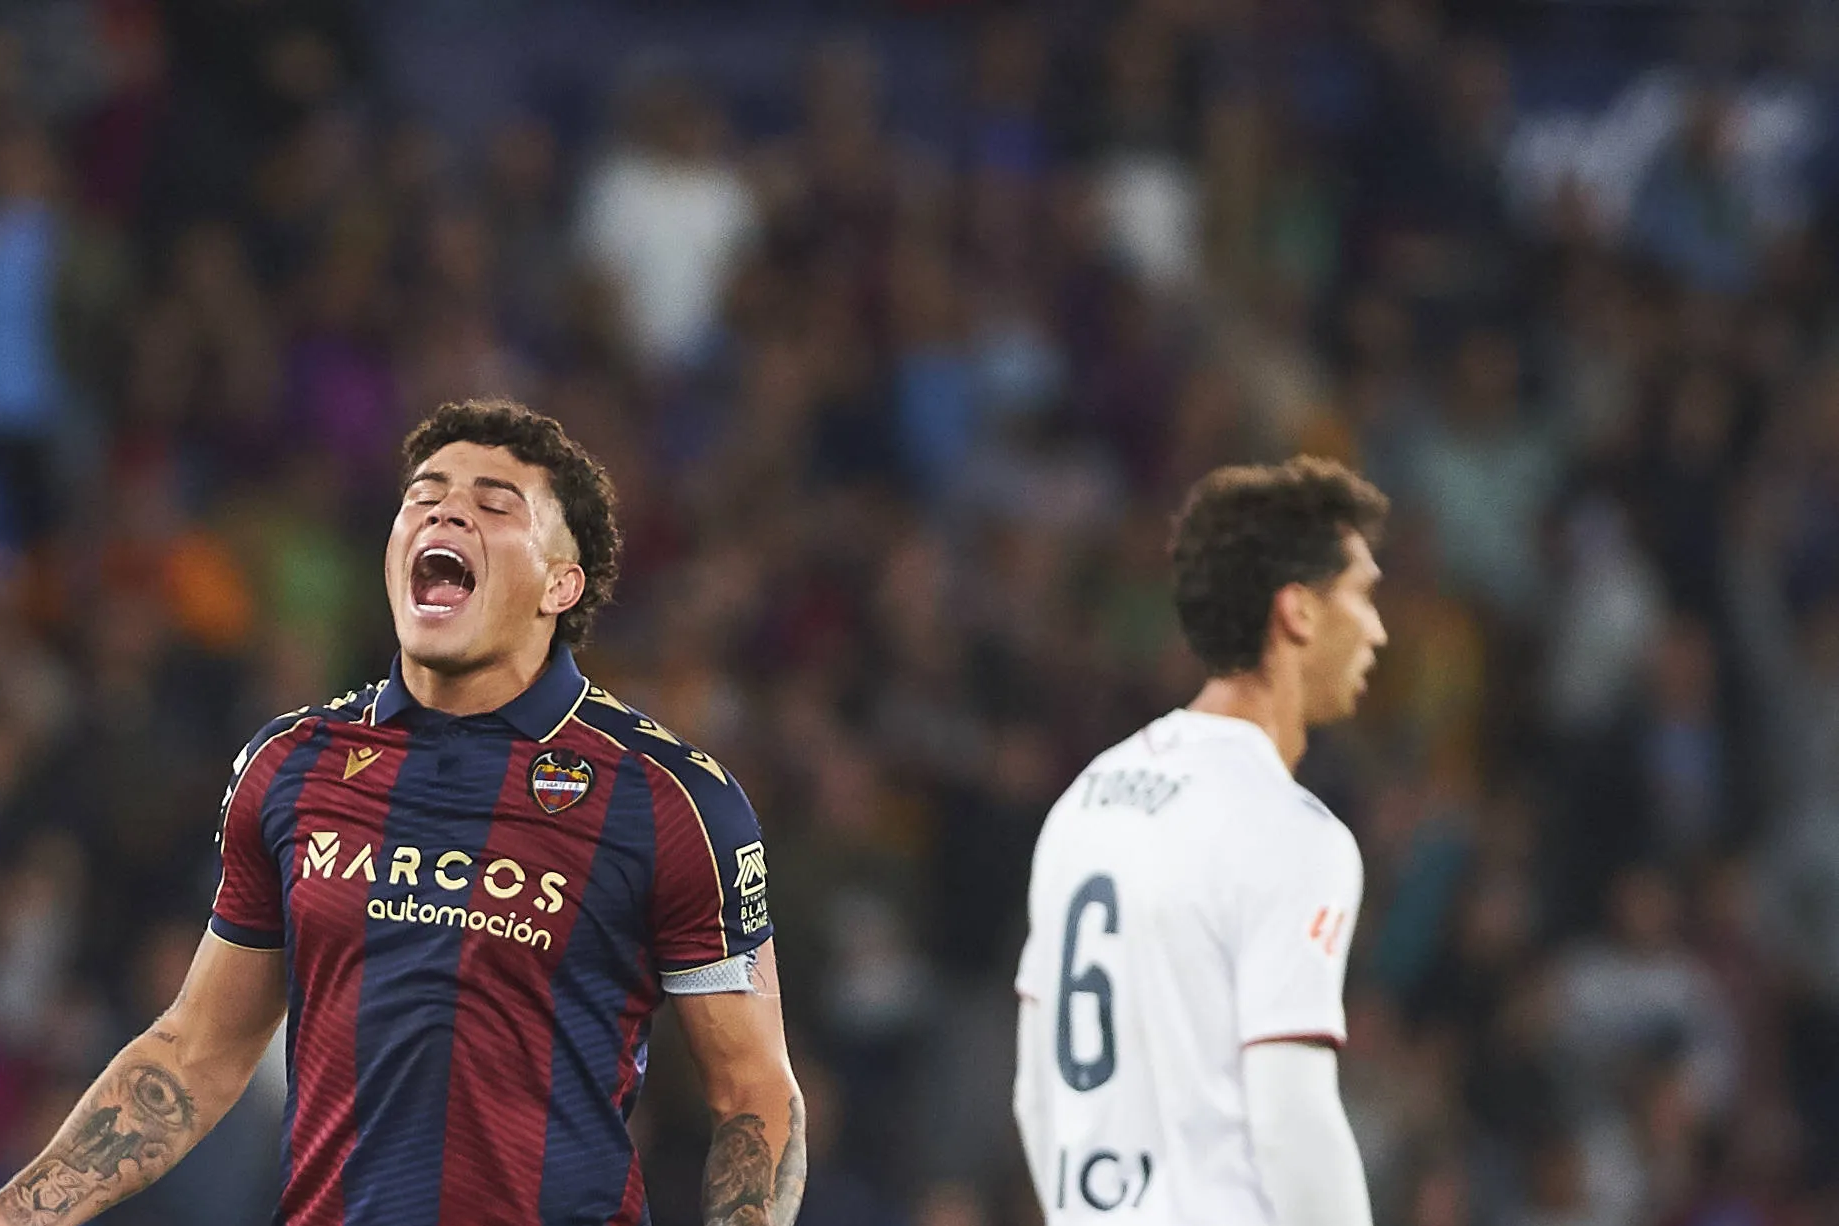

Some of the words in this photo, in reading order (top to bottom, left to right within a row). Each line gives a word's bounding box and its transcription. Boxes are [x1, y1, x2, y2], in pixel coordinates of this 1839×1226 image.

[302, 831, 568, 913] MARCOS
[367, 894, 552, 951] automoción
[1056, 872, 1120, 1091] 6
